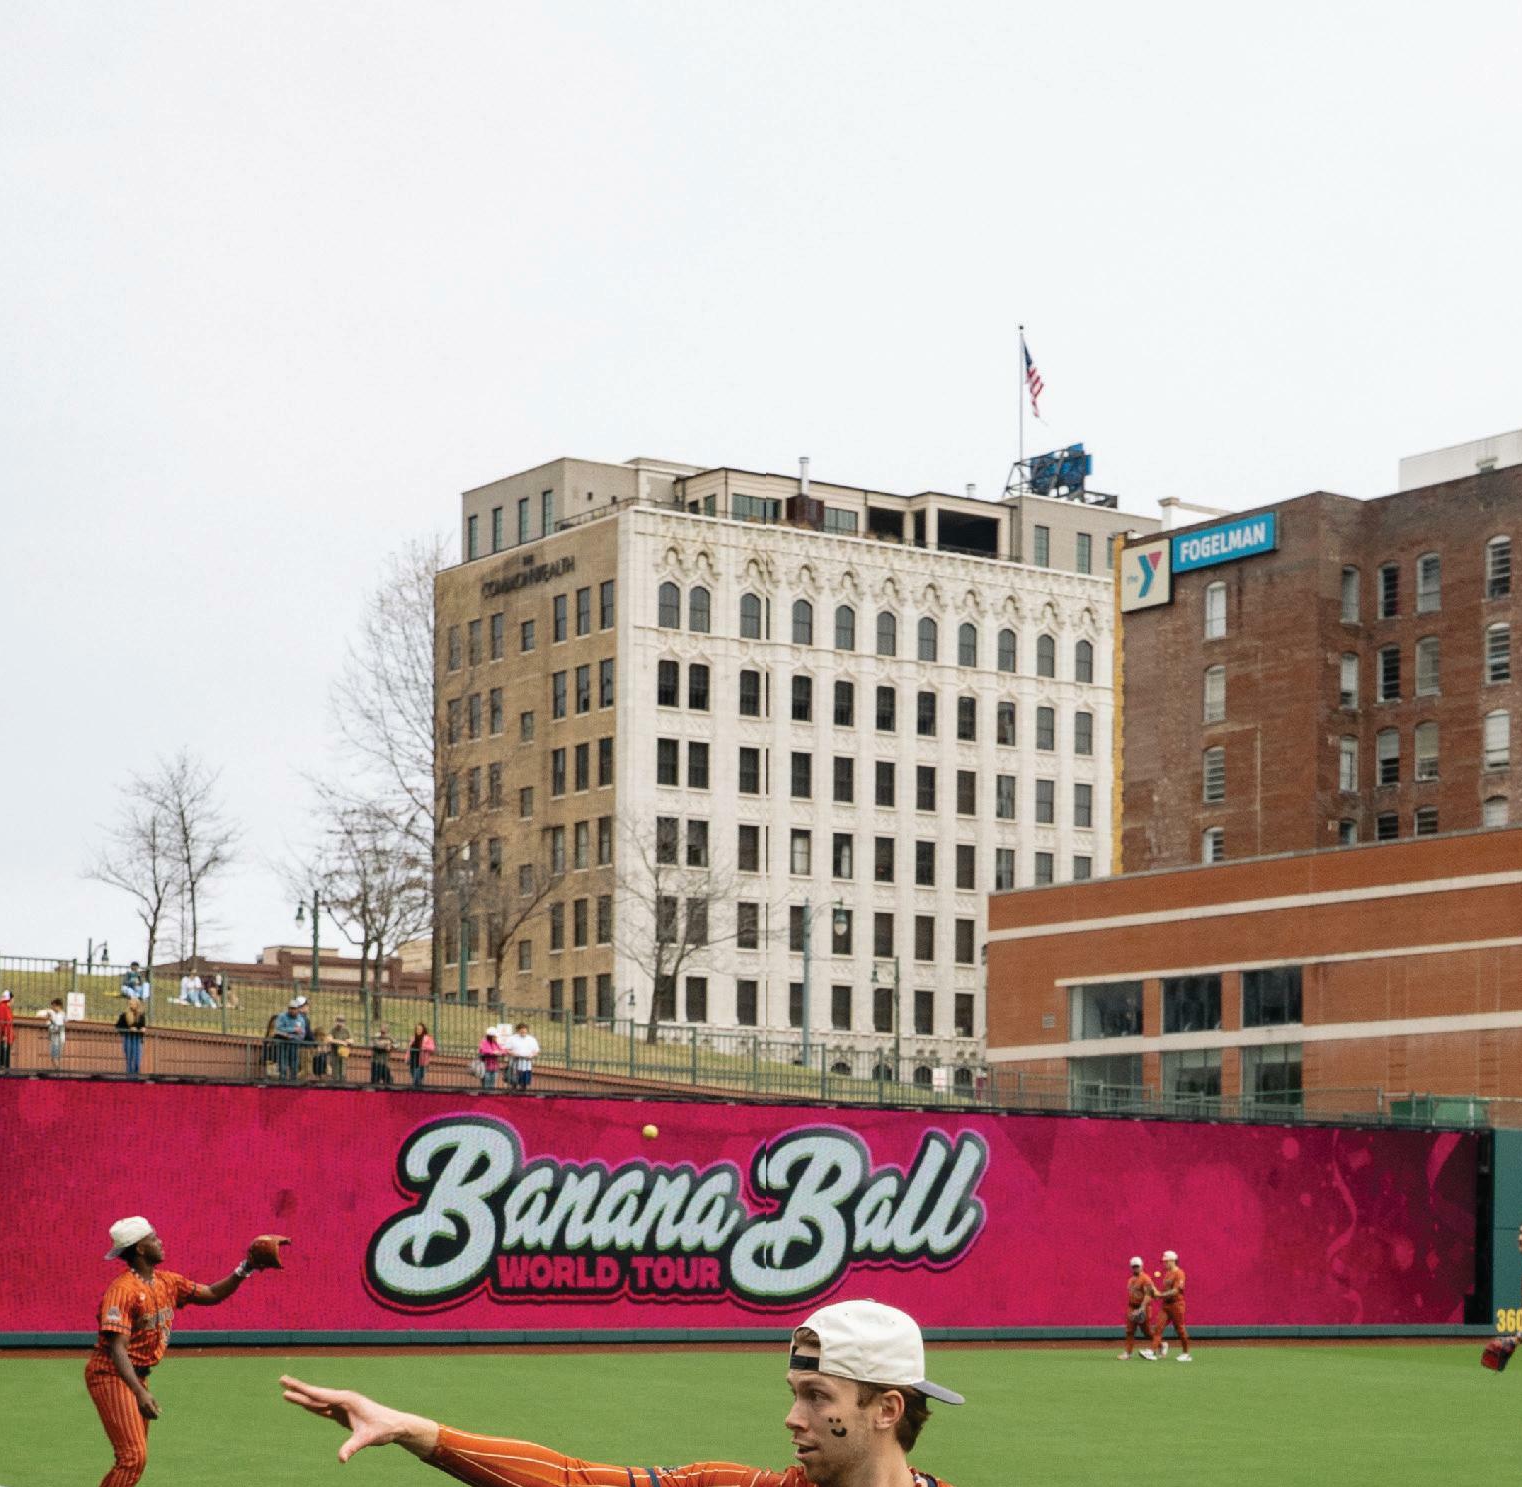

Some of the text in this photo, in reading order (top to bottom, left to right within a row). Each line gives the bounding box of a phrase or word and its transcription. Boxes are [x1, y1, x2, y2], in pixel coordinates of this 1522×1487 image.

[1180, 522, 1266, 563] FOGELMAN
[373, 1124, 983, 1296] Banana Ball
[498, 1256, 722, 1291] WORLD TOUR
